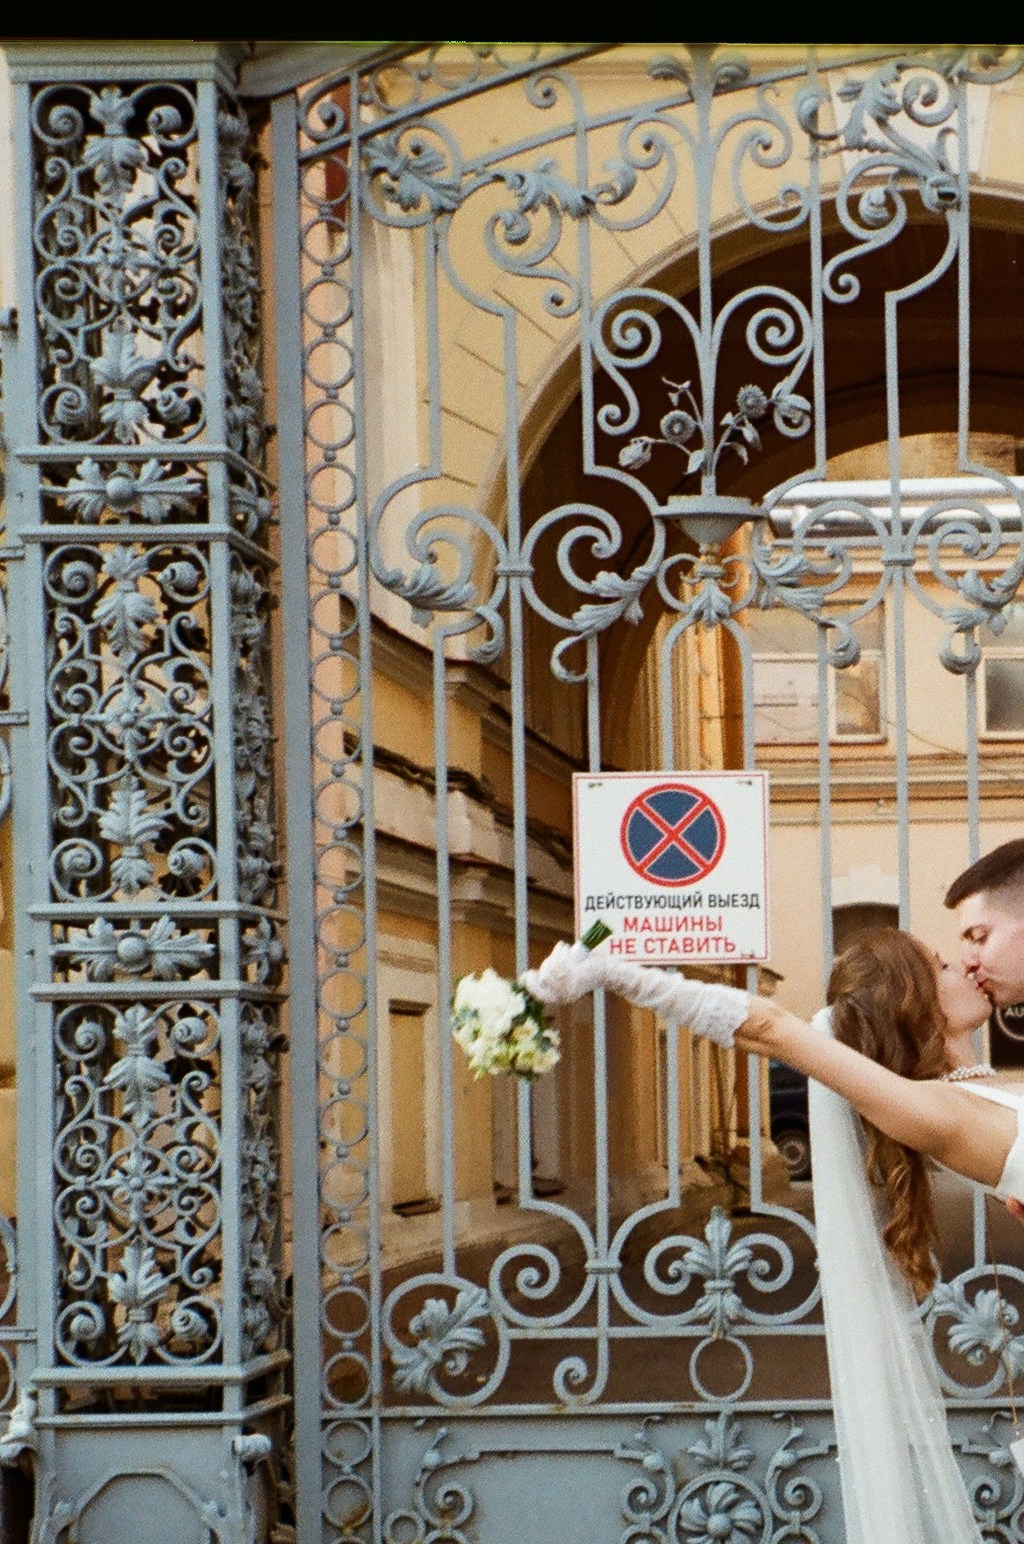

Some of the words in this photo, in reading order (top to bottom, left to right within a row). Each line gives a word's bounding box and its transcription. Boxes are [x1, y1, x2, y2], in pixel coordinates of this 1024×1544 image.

[585, 892, 703, 912] ДЕЙСТВУЮЩИЙ
[708, 893, 760, 909] ВЫЕЗД
[623, 915, 723, 933] МАШИНЫ
[609, 938, 636, 955] НЕ
[644, 937, 736, 954] СТАВИТЬ
